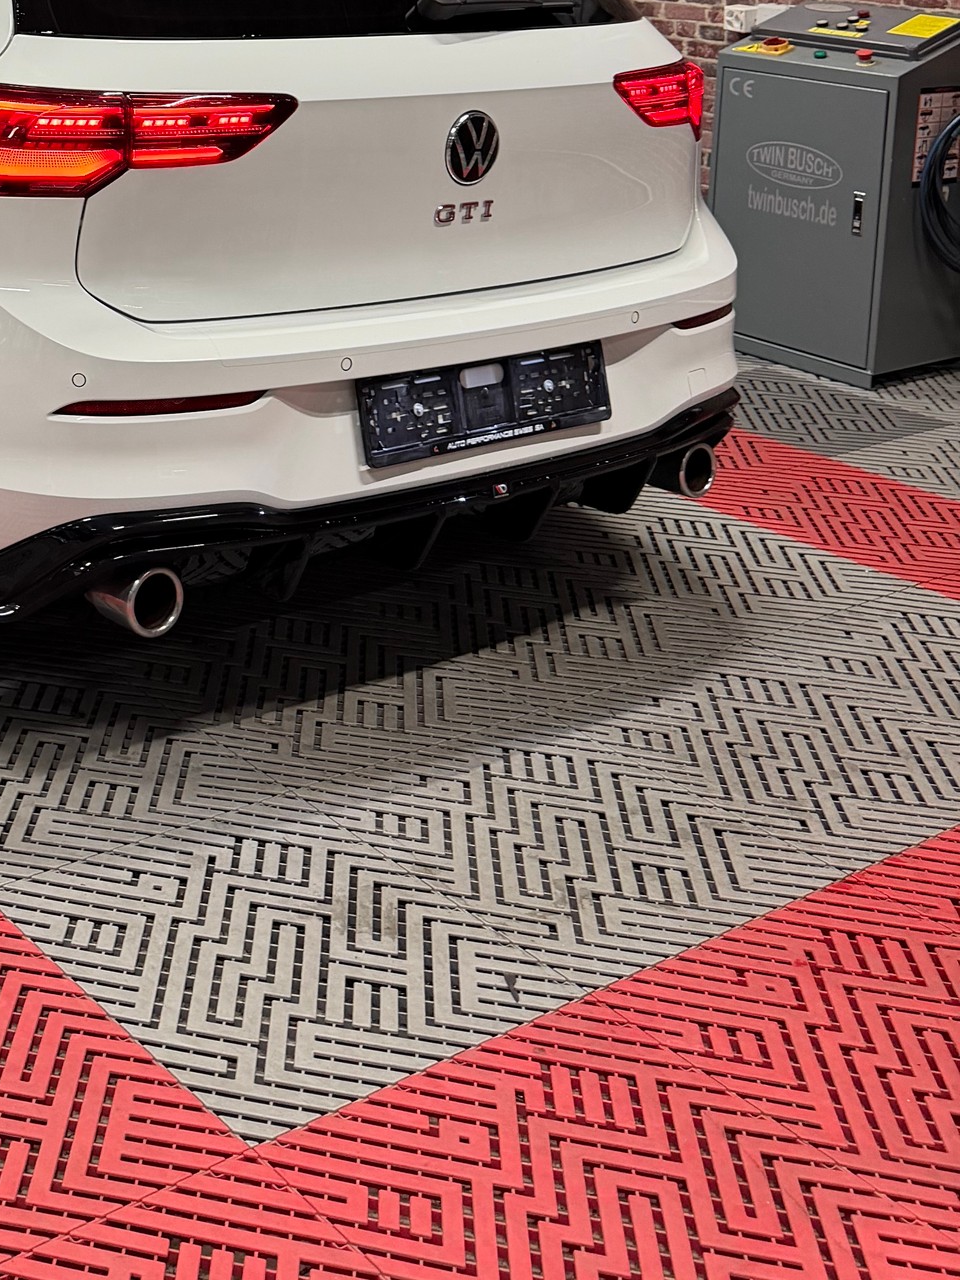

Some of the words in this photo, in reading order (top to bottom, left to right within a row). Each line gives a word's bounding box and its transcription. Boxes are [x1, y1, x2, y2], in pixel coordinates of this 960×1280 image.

[751, 145, 785, 167] TWIN
[787, 147, 833, 178] BUSCH
[771, 169, 814, 185] GERMANY
[434, 200, 494, 223] GTI
[747, 184, 837, 226] twinbusch.de
[447, 439, 466, 450] AUTO
[467, 429, 513, 446] PERFORMANCE
[534, 423, 545, 432] SA
